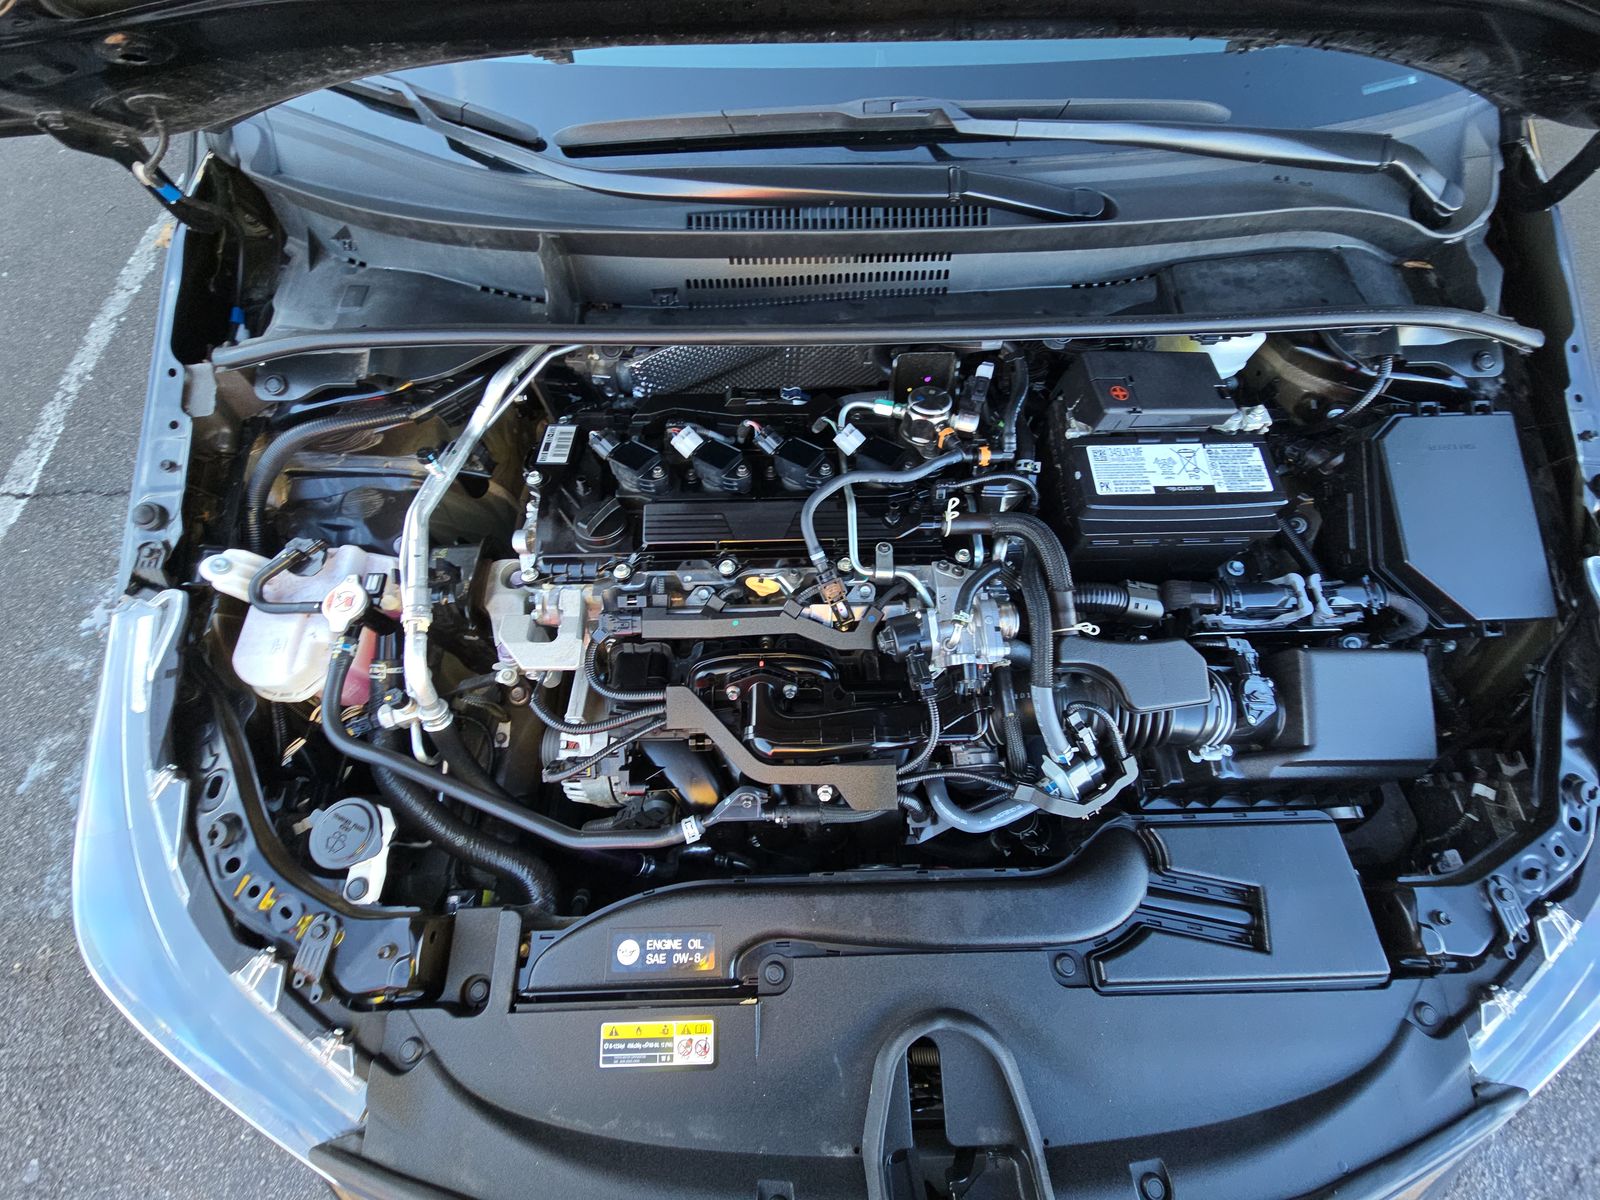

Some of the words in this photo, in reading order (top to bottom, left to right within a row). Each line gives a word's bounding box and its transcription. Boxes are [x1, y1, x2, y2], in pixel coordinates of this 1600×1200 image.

[1099, 481, 1112, 492] PK
[646, 939, 683, 951] ENGINE
[687, 939, 705, 950] OIL
[645, 953, 667, 965] SAE
[672, 952, 701, 964] 0W-8
